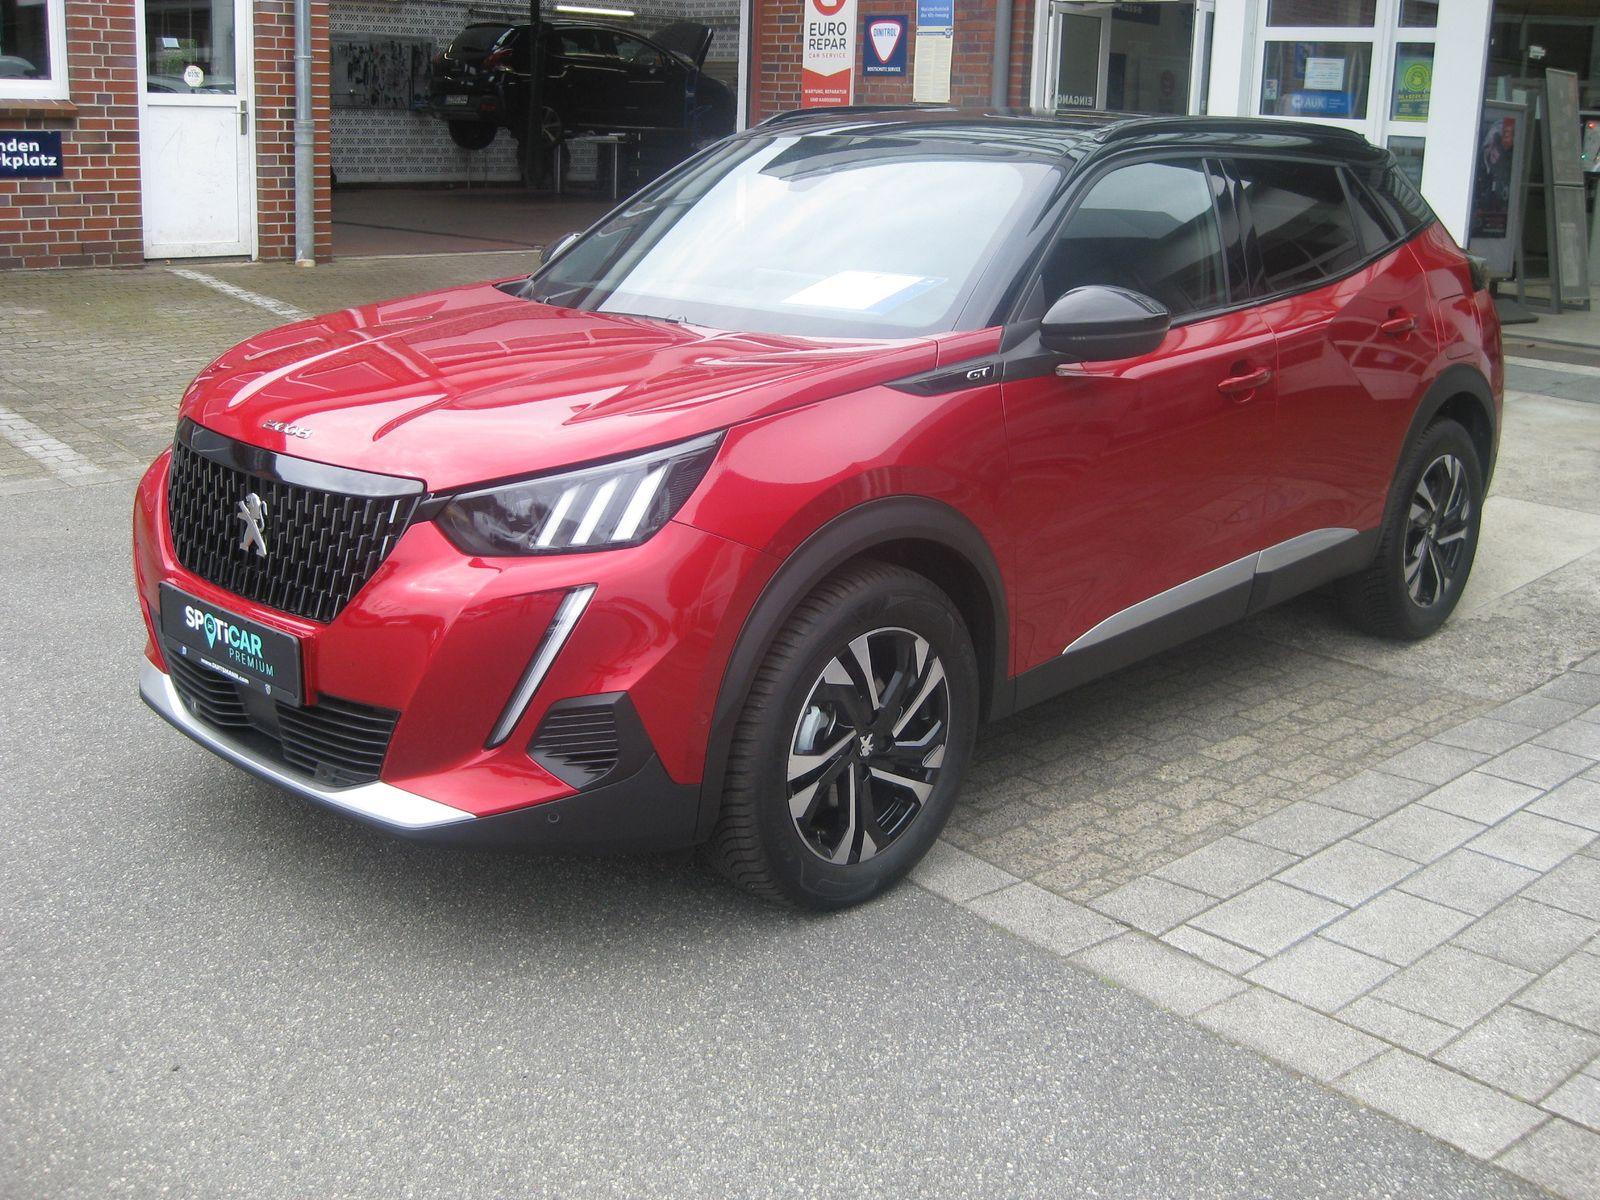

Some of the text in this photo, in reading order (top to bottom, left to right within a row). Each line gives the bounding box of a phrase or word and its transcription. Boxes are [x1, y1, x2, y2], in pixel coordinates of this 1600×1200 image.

[809, 21, 847, 37] EURO
[873, 27, 898, 37] DINITROL
[808, 38, 847, 51] REPAR
[0, 153, 58, 170] kplatz
[966, 366, 990, 380] GT
[261, 419, 313, 440] 2008
[229, 647, 274, 677] PREMIUM
